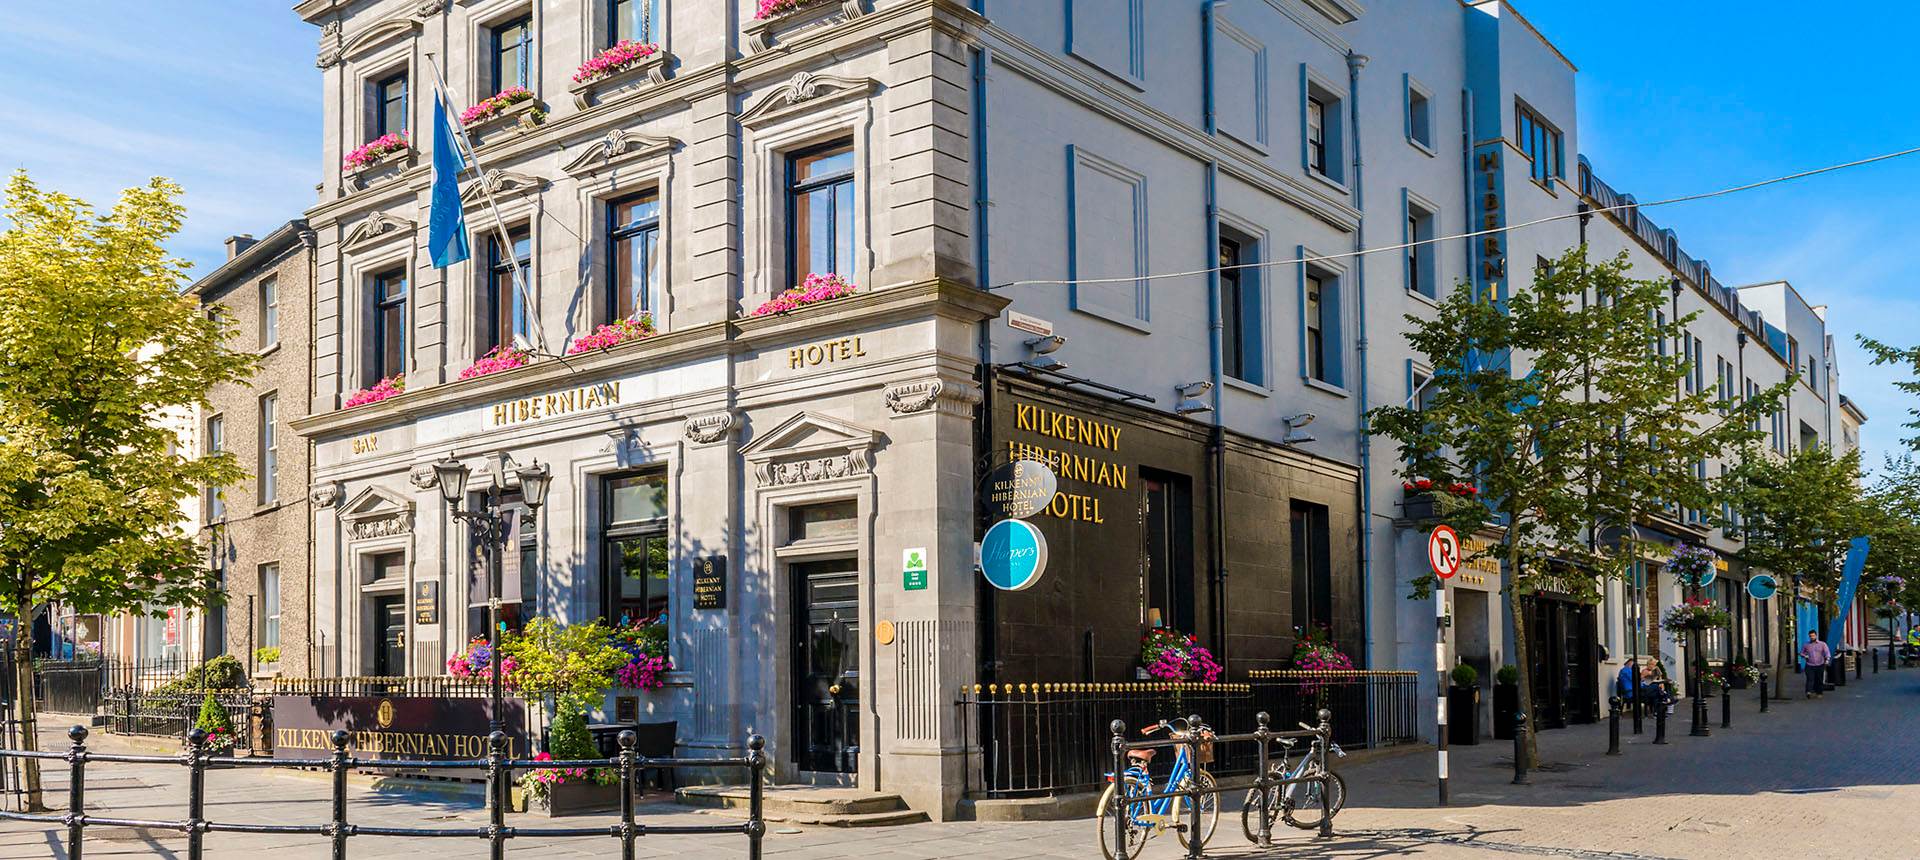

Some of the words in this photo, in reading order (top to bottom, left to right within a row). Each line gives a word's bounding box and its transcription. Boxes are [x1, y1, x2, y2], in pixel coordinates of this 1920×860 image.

[788, 336, 866, 369] HOTEL
[494, 381, 621, 426] HIBERNIAN
[1016, 403, 1121, 451] KILKENNY
[352, 433, 378, 454] BAR
[1009, 440, 1127, 489] HIBERNIAN
[991, 488, 1047, 502] HIBERNIAN
[994, 475, 1044, 490] KILKENNY
[1002, 500, 1034, 513] HOTEL
[1044, 491, 1104, 524] OTEL
[277, 728, 352, 752] KILKEN
[356, 731, 450, 756] HIBERNIAN
[455, 735, 521, 760] HOTL
